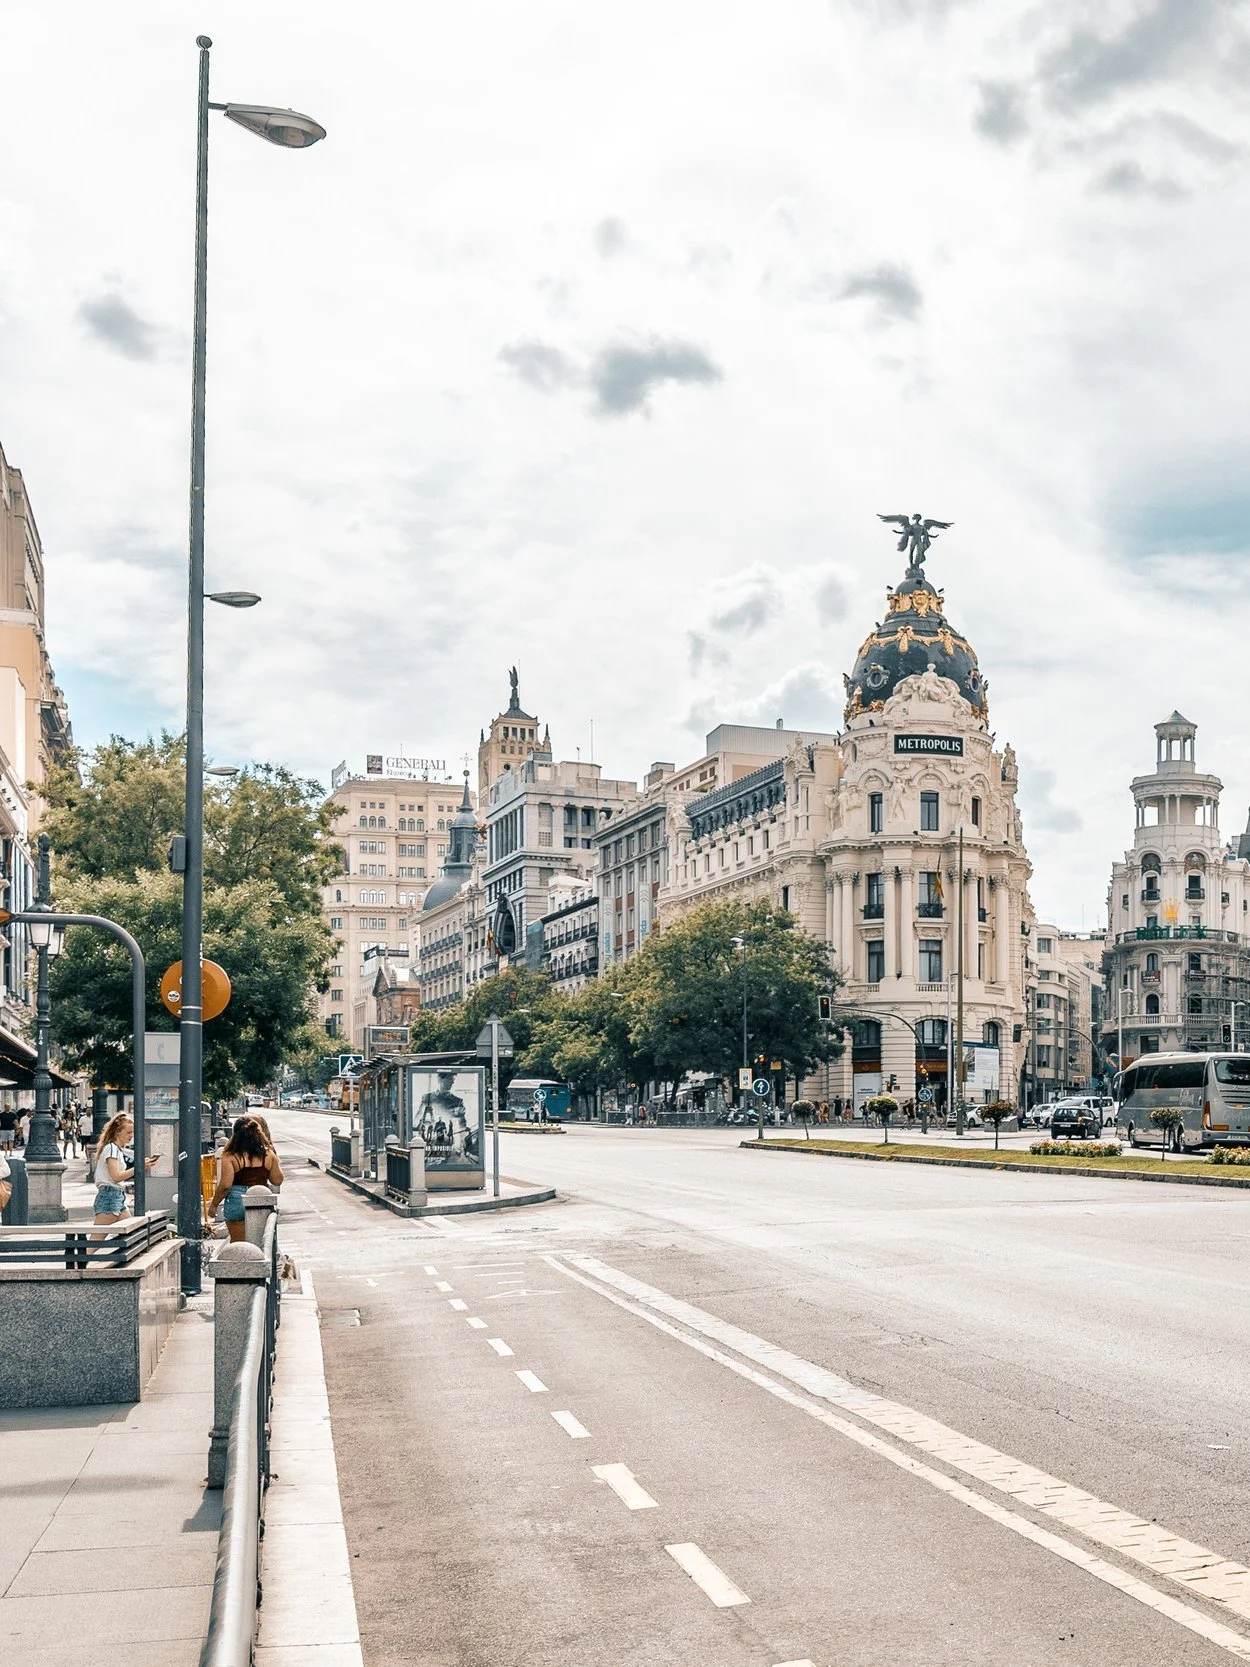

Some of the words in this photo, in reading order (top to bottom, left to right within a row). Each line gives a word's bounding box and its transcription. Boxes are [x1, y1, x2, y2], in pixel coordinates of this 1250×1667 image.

[898, 738, 961, 752] METROPOLIS
[386, 757, 446, 771] GENERALI
[1136, 925, 1207, 940] ROLEX
